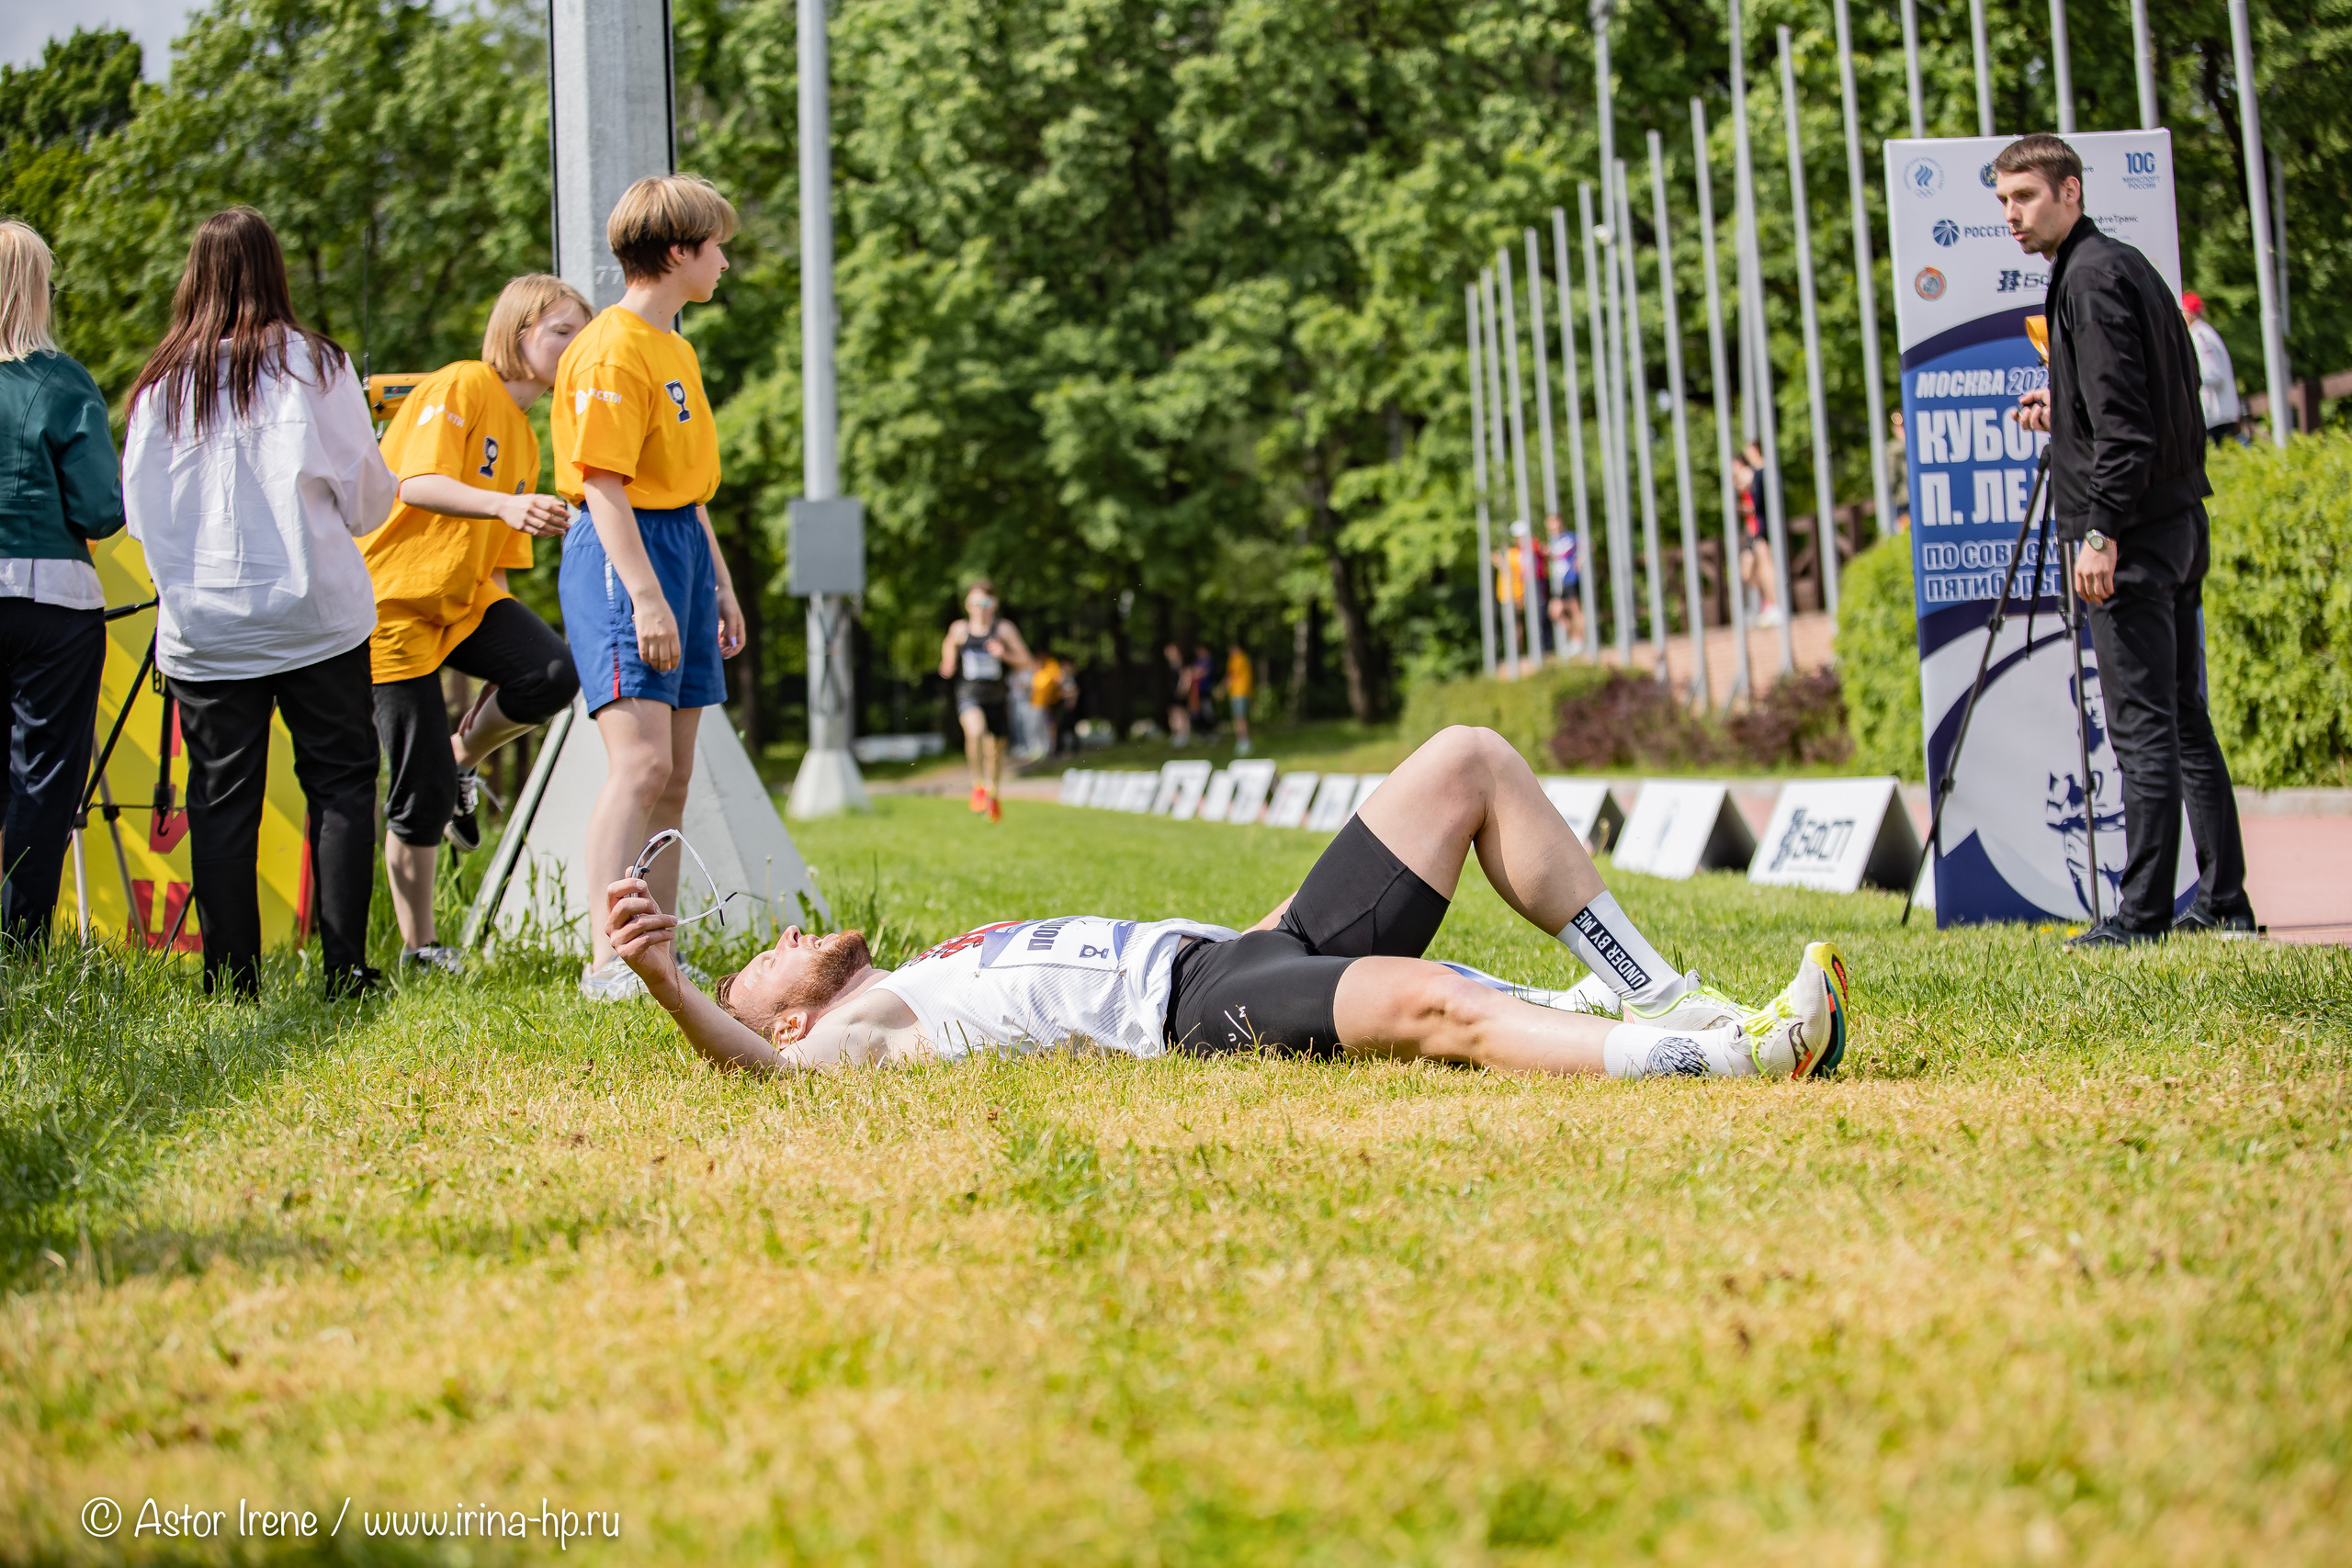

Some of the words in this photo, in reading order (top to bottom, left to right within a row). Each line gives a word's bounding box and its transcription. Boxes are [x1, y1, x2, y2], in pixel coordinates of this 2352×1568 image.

[1916, 368, 2006, 399] МОСКВА
[2006, 367, 2050, 396] 202
[1919, 471, 1964, 526] П.
[1922, 542, 1960, 570] ПО
[1574, 909, 1598, 934] ME
[1589, 929, 1612, 951] BY
[1605, 943, 1646, 989] UNDER
